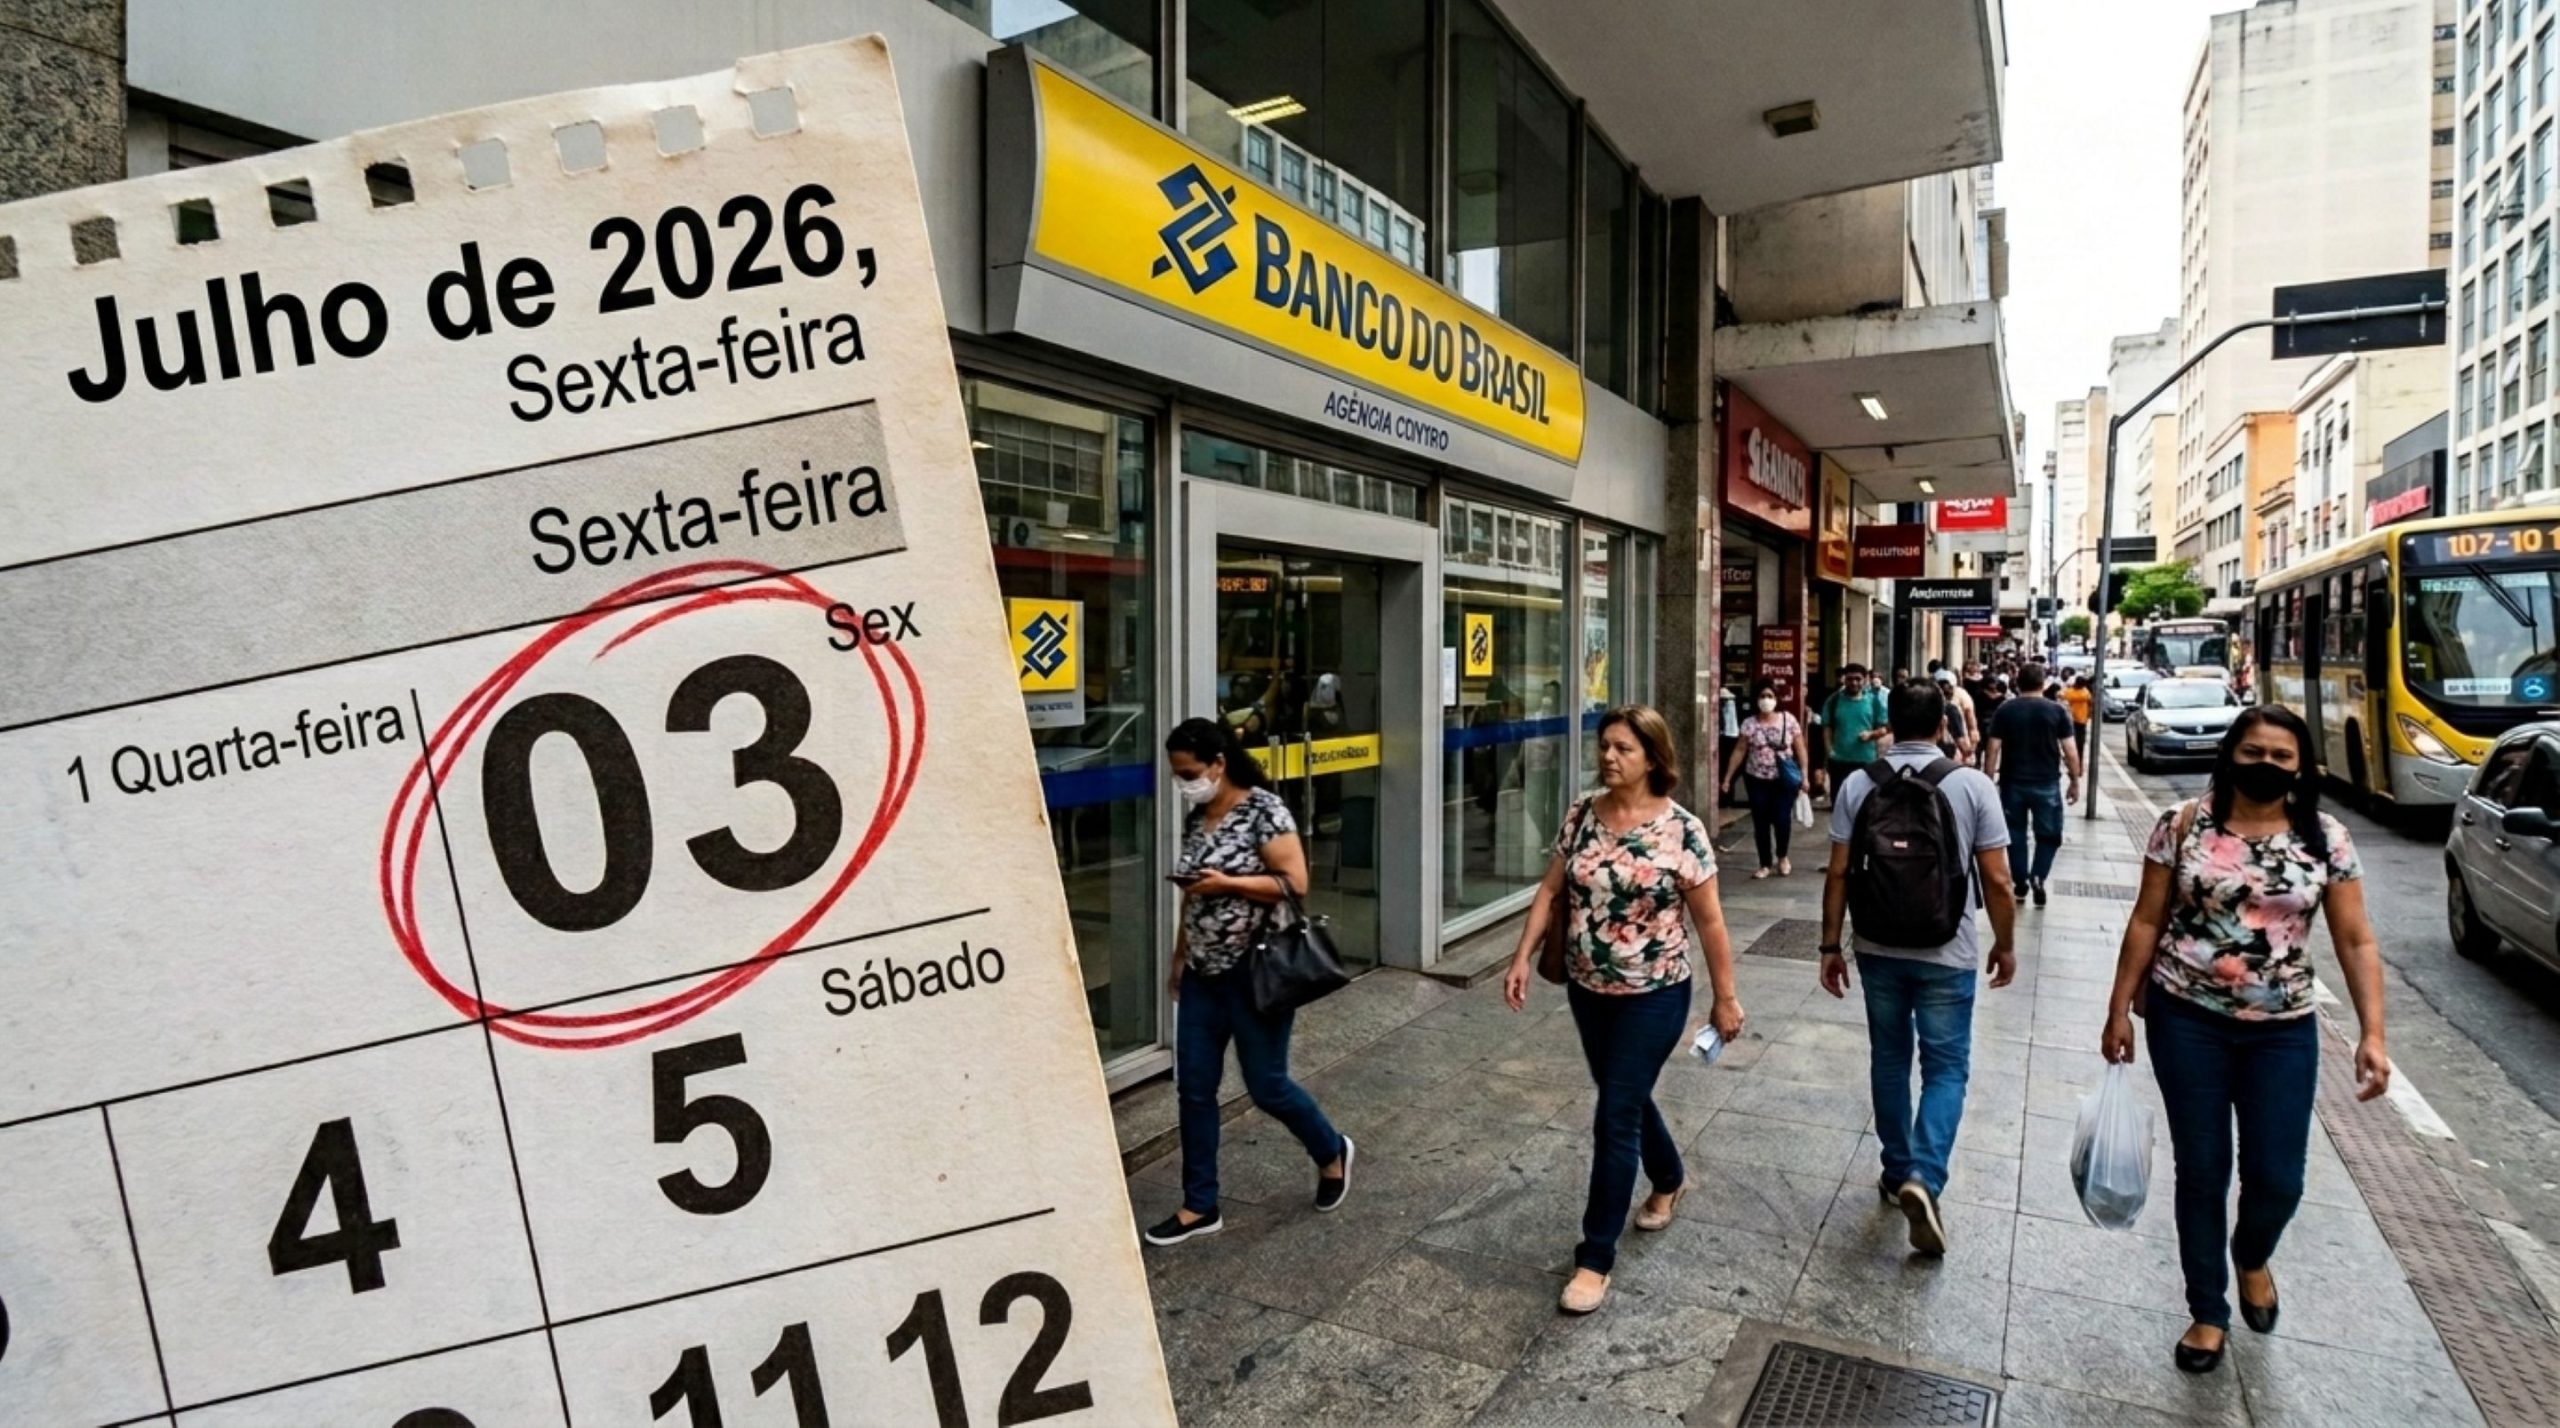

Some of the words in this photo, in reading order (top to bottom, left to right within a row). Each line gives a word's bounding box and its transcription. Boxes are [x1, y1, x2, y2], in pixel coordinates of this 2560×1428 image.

[67, 270, 390, 404] Julho
[427, 240, 557, 342] de
[590, 182, 877, 314] 2026,
[506, 307, 867, 423] Sexta-feira
[1254, 213, 1405, 361] BANCO
[1409, 306, 1455, 384] DO
[1459, 321, 1550, 425] BRASIL
[529, 460, 889, 576] Sexta-feira
[825, 601, 922, 652] Sex
[67, 754, 91, 804] 1
[111, 700, 406, 796] Quarta-feira
[481, 654, 843, 932] 03
[821, 939, 1005, 1017] Sábado
[652, 1032, 772, 1215] 5
[267, 1116, 401, 1295] 4
[886, 1271, 1095, 1428] 12
